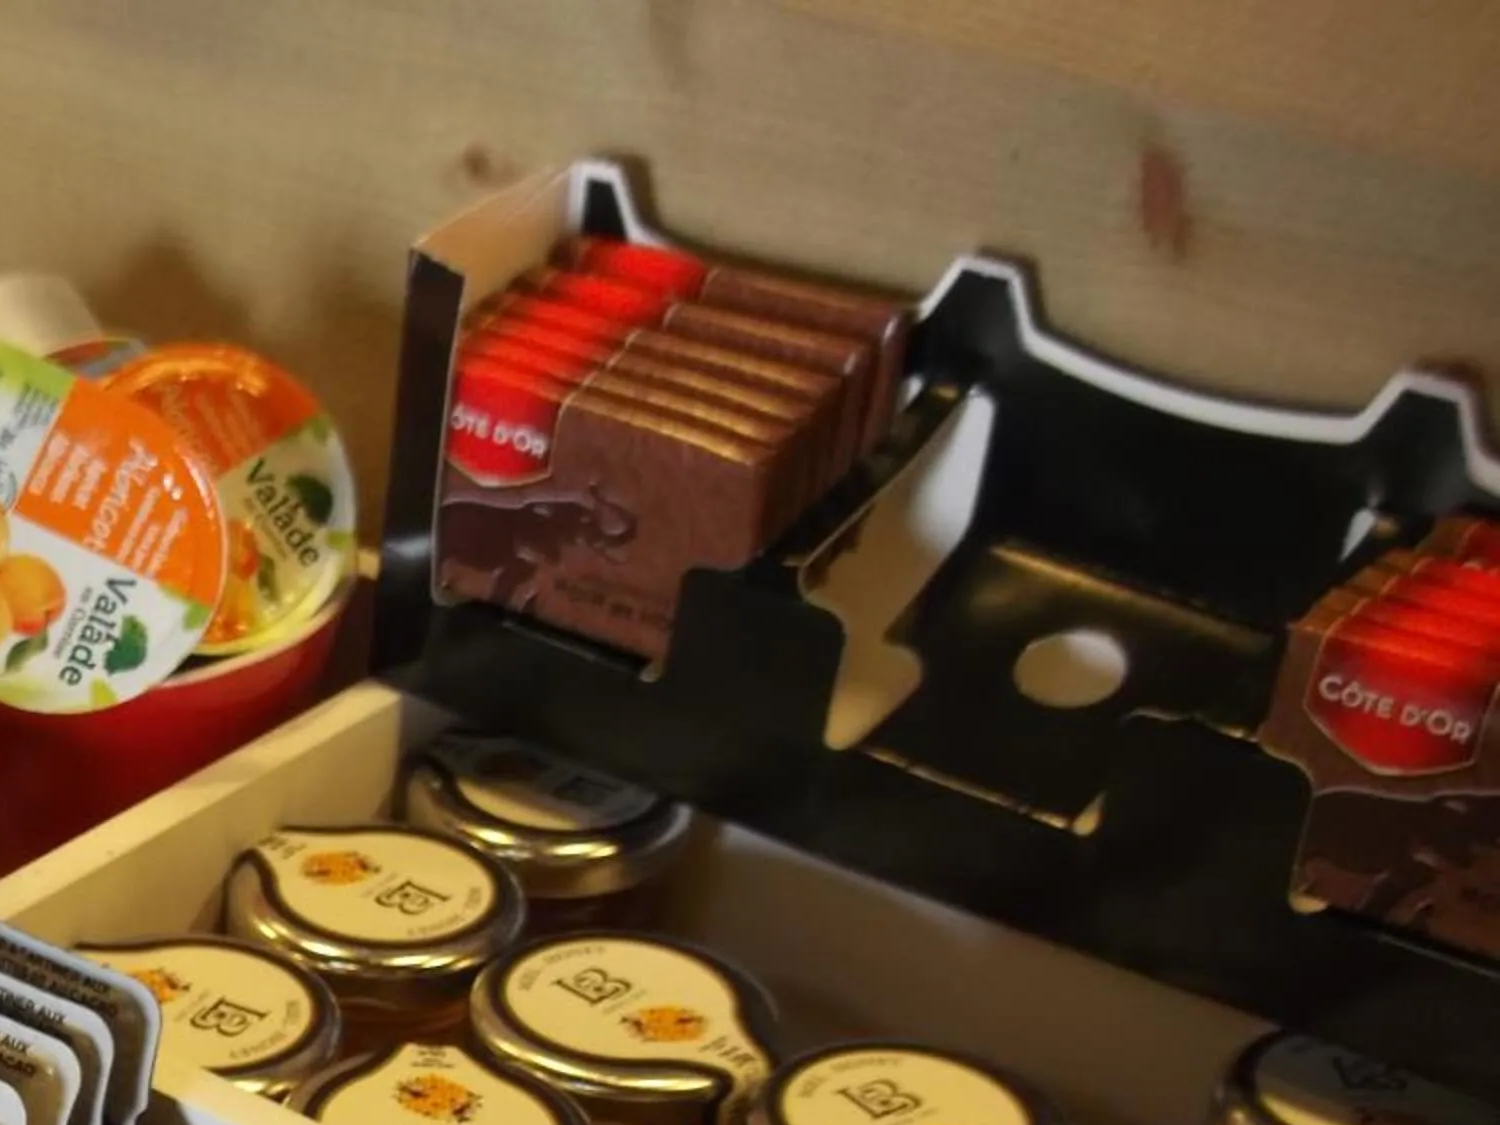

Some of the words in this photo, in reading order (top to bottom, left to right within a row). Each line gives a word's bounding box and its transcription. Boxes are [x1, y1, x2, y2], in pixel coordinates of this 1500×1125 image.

[451, 403, 490, 439] ÔTE
[245, 457, 320, 567] Valade
[59, 576, 137, 686] Valade
[1318, 674, 1395, 719] CÔTE
[1400, 704, 1472, 745] D'OR
[0, 1036, 32, 1056] AUX
